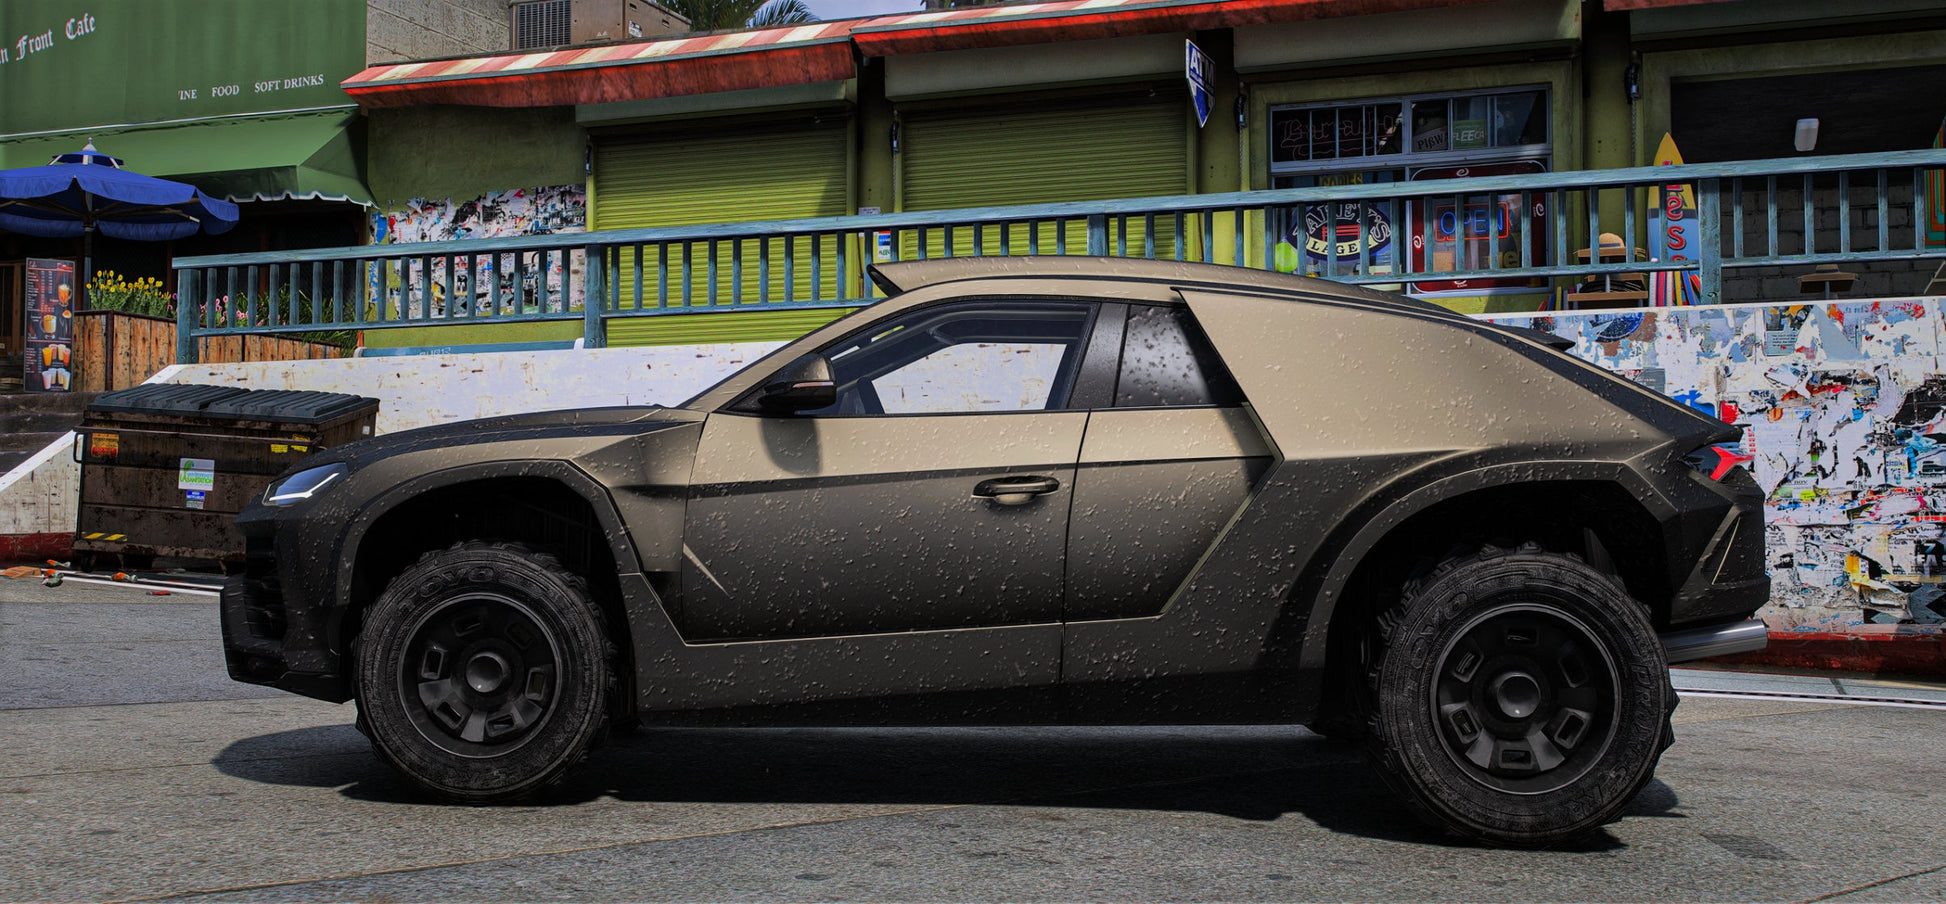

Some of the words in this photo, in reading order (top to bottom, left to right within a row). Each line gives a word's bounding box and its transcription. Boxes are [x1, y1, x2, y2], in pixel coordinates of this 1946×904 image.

[15, 28, 54, 61] Front
[65, 12, 96, 40] Cafe
[178, 89, 198, 100] INE
[211, 84, 240, 97] FOOD
[254, 80, 281, 93] SOFT
[284, 74, 324, 89] DRINKS
[1190, 47, 1215, 88] ATM
[1311, 239, 1372, 255] LAGE
[399, 566, 494, 613] TOYO
